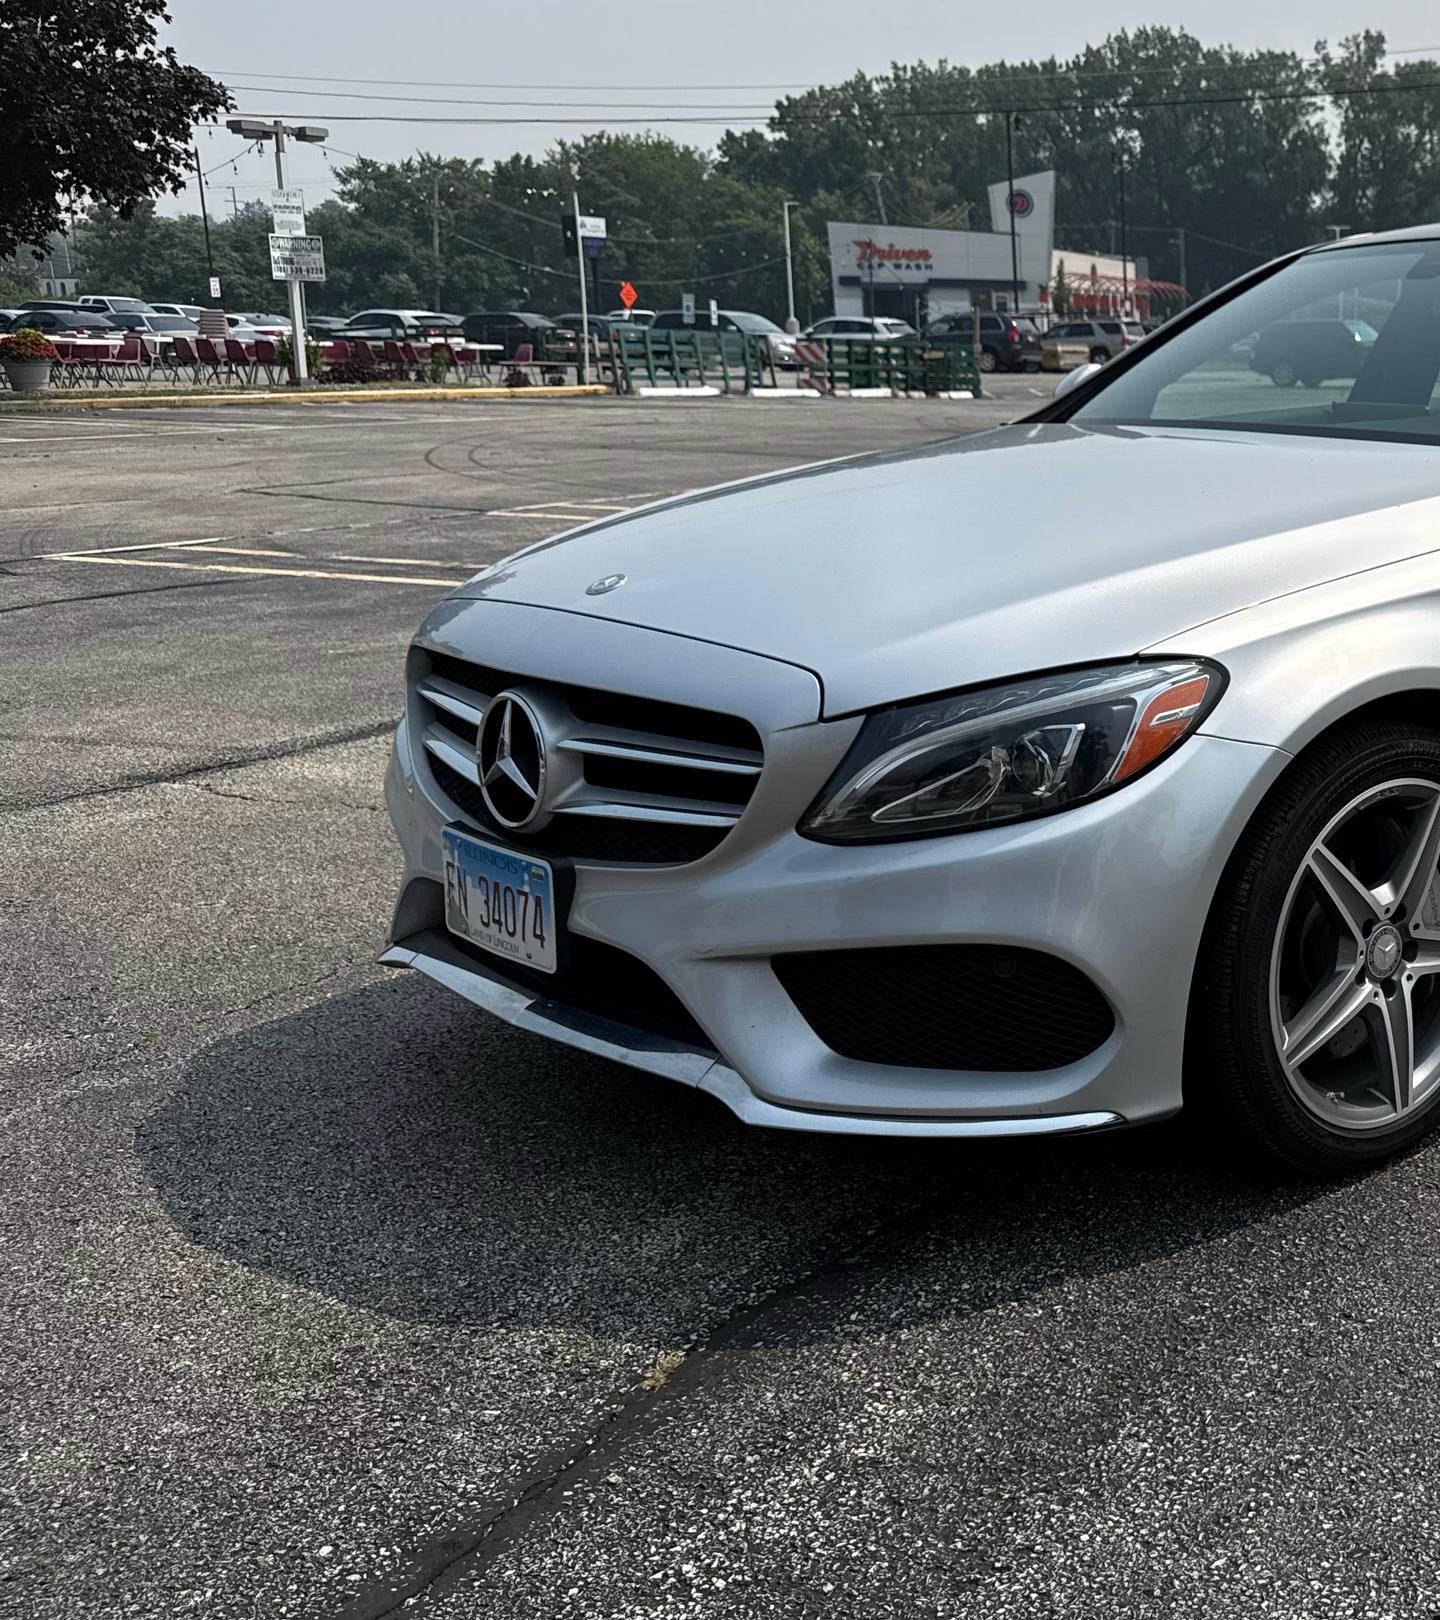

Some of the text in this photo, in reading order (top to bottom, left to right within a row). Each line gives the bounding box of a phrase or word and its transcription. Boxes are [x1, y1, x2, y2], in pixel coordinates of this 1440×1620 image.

[280, 237, 312, 250] WARNING
[852, 238, 932, 261] Driven
[893, 262, 933, 271] WASH
[465, 845, 518, 874] ILLINOIS
[478, 875, 546, 949] 34074
